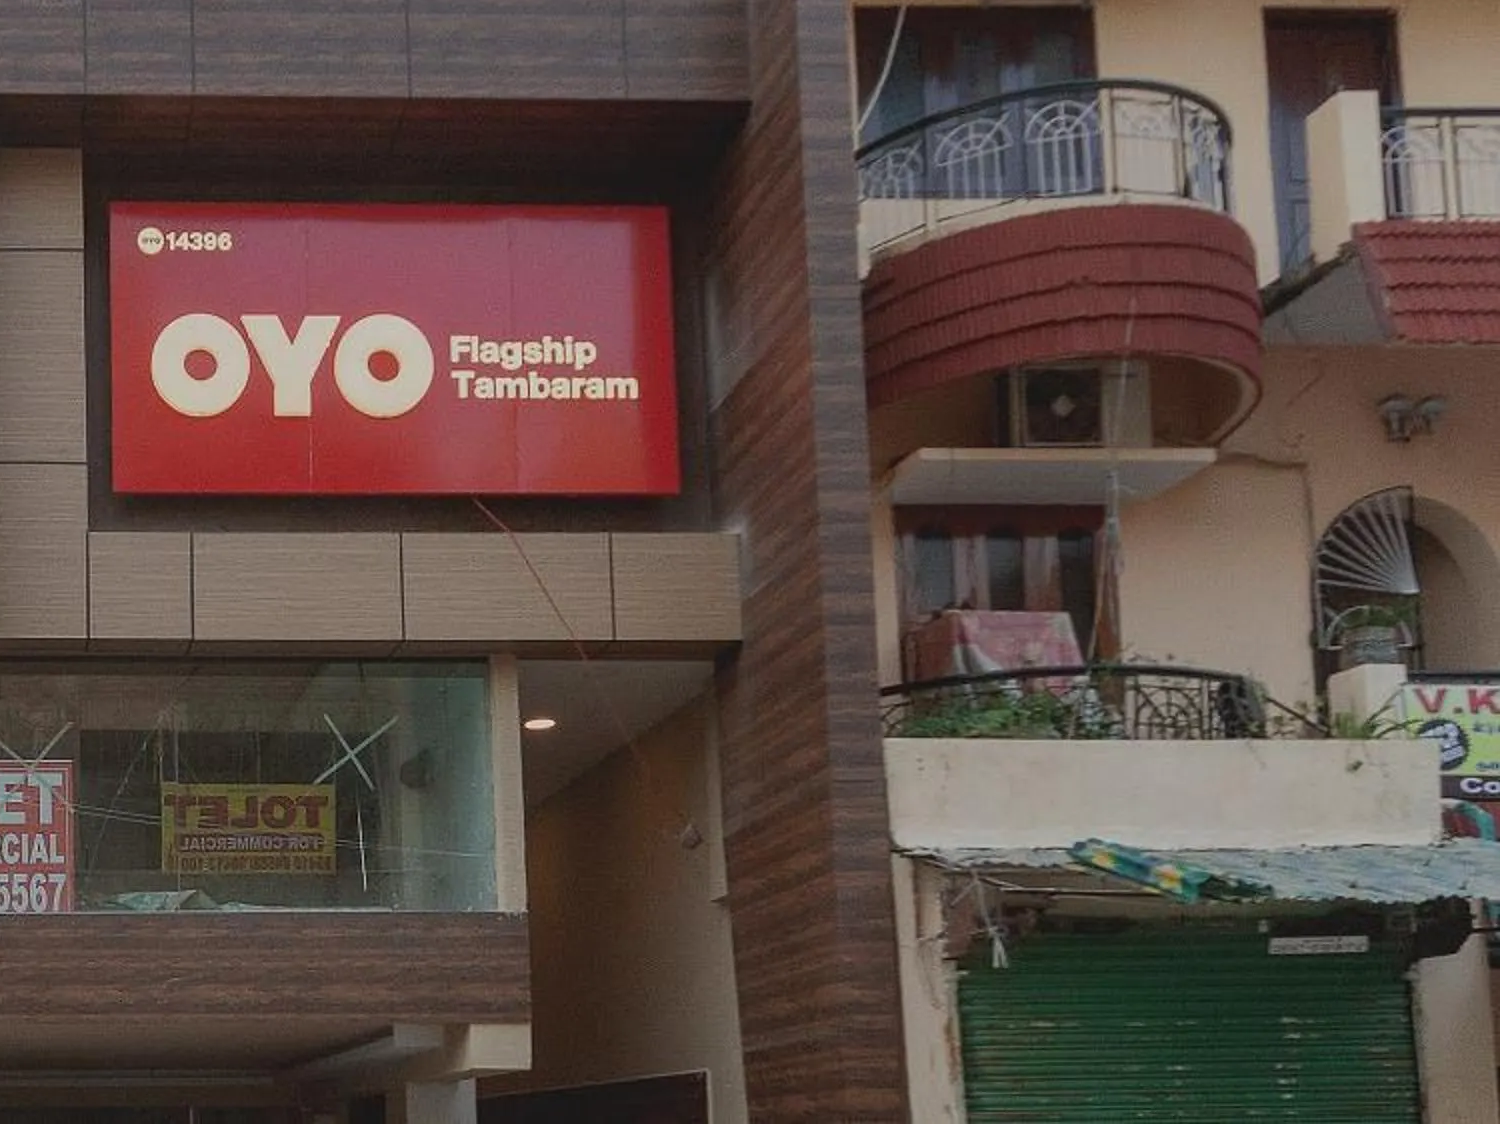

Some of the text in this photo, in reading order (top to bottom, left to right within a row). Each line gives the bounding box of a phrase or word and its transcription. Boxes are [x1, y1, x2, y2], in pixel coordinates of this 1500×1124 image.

[166, 231, 232, 251] 14396
[151, 314, 434, 418] OYO
[449, 335, 597, 370] Flagship
[450, 370, 639, 400] Tambaram
